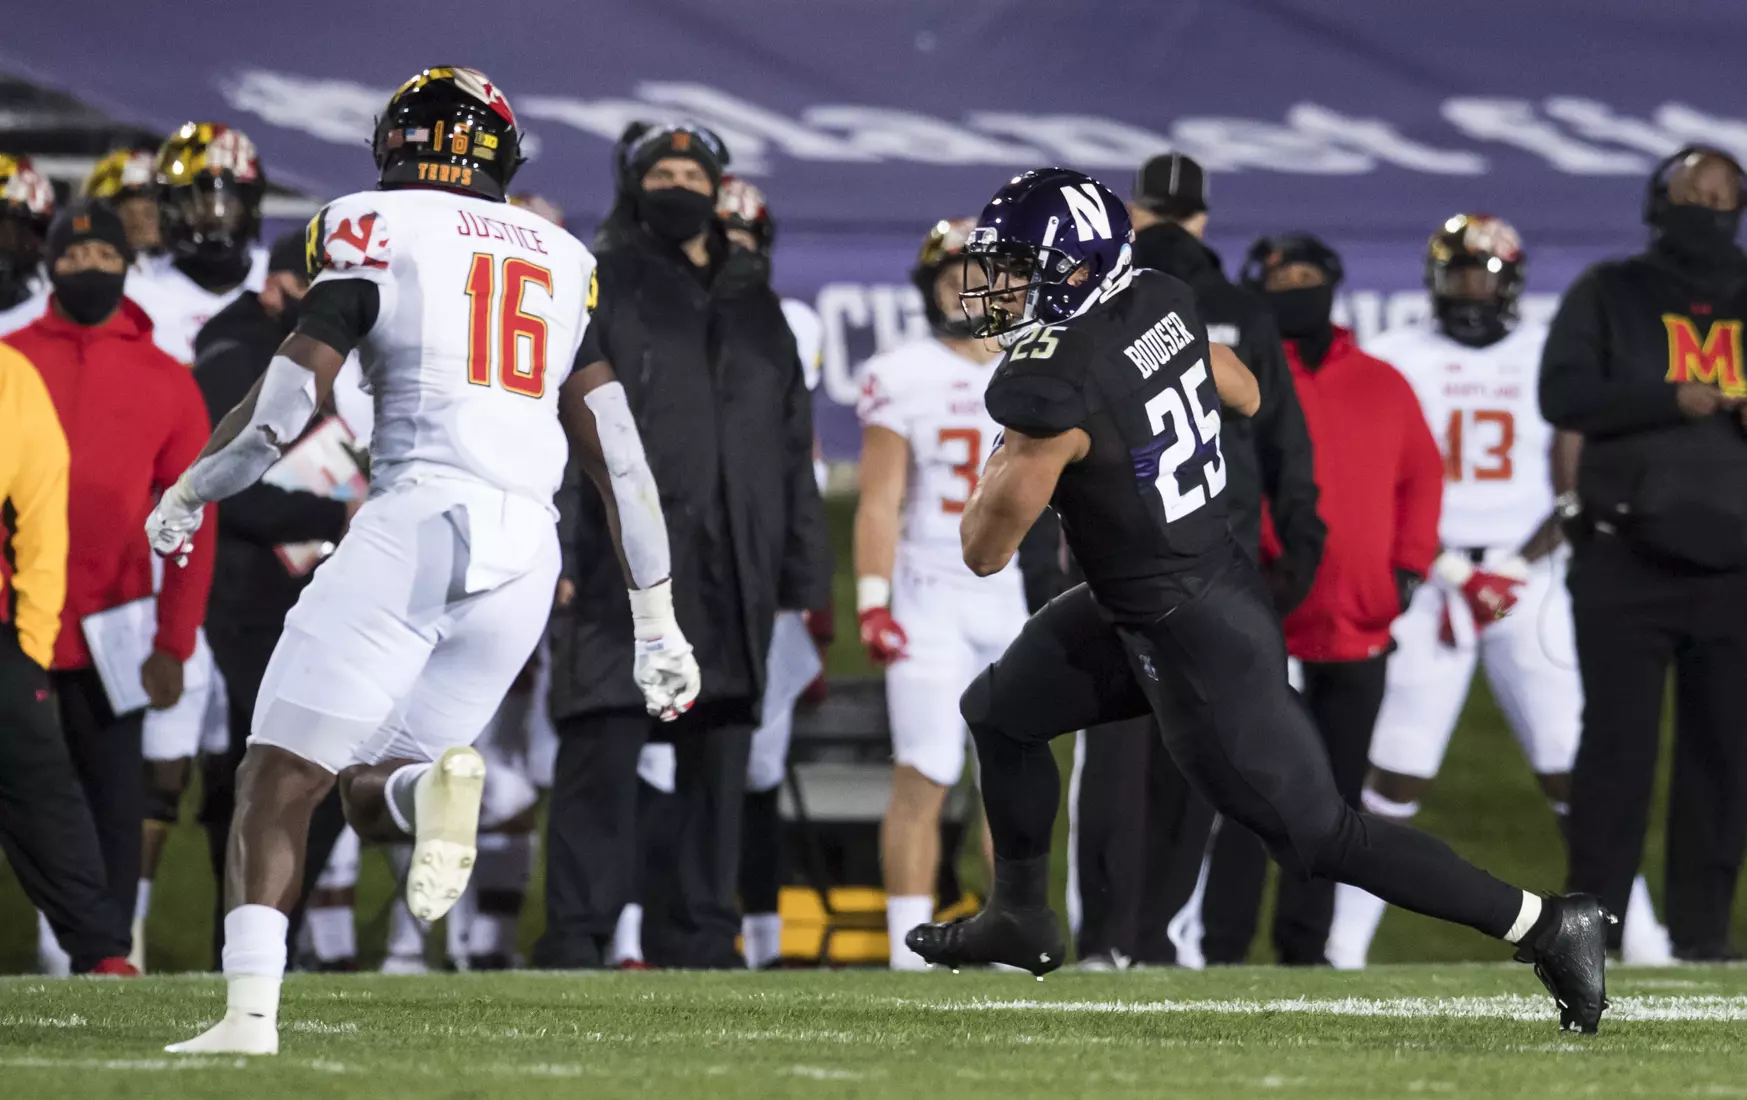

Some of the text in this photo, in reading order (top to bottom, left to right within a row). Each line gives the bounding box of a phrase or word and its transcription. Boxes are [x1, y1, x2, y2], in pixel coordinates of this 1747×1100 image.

[433, 120, 470, 154] 16
[418, 162, 473, 186] TERPS
[457, 210, 548, 255] JUSTICE
[1060, 183, 1113, 242] N
[464, 252, 554, 400] 16
[1009, 326, 1069, 362] 25
[1123, 311, 1196, 380] BOWSER
[1661, 313, 1747, 398] M
[1144, 358, 1227, 524] 25
[1446, 409, 1515, 483] 13
